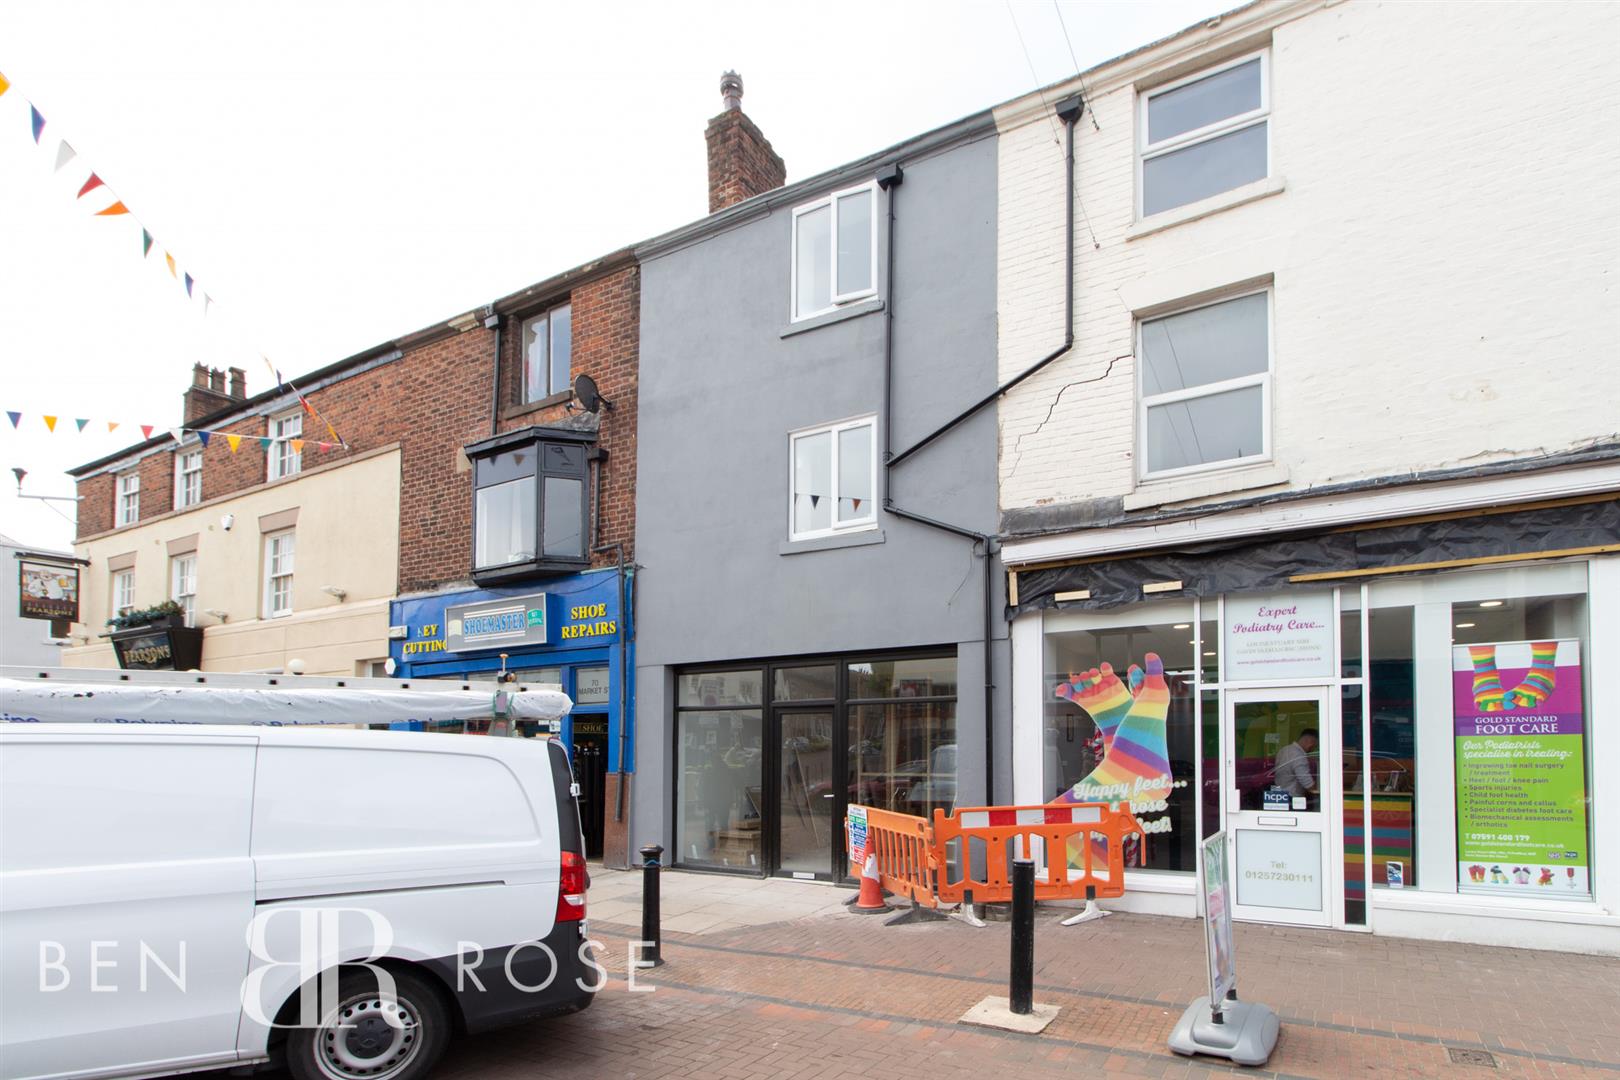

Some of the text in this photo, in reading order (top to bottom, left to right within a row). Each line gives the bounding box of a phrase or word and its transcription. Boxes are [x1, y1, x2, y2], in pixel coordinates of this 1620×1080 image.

[571, 603, 607, 620] SHOE
[1258, 605, 1297, 618] Expert
[464, 612, 525, 636] SHOEMASTER
[561, 621, 617, 640] REPAIRS
[1232, 619, 1325, 633] Podiatry Care...
[123, 645, 170, 664] PEARSONS
[579, 687, 602, 695] MARKET
[1475, 715, 1558, 724] GOLD STANDARD
[1475, 723, 1559, 735] FOOT CARE
[1073, 782, 1129, 800] Happy
[1264, 791, 1288, 802] hcpc
[1270, 861, 1287, 869] Tel:
[1245, 870, 1313, 882] 01257230111
